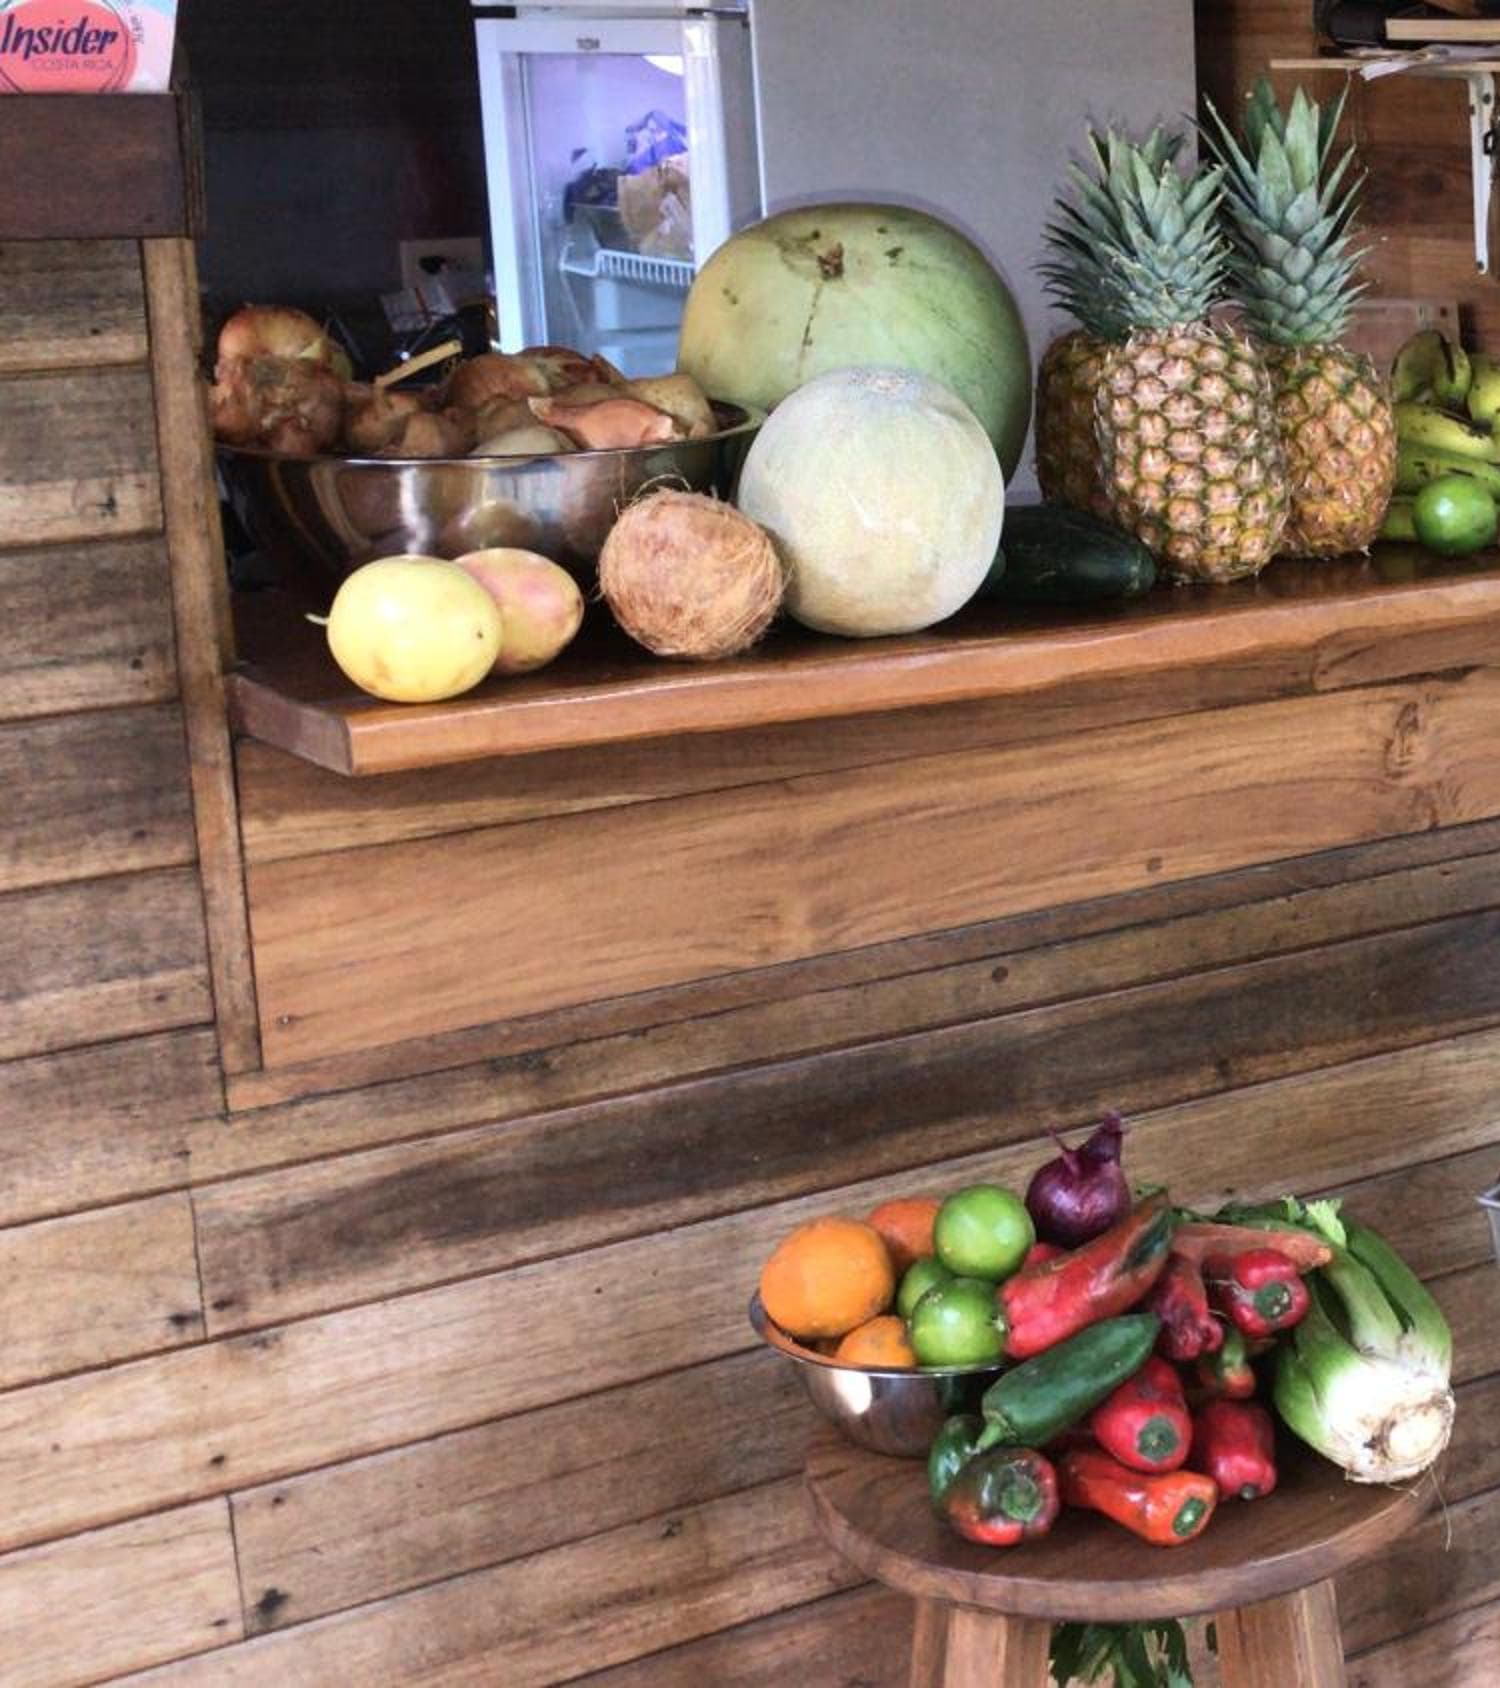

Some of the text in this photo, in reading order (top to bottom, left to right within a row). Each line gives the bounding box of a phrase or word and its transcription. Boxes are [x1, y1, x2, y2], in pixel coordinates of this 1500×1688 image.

[0, 13, 118, 60] Insider
[32, 58, 113, 71] COSTA RICA
